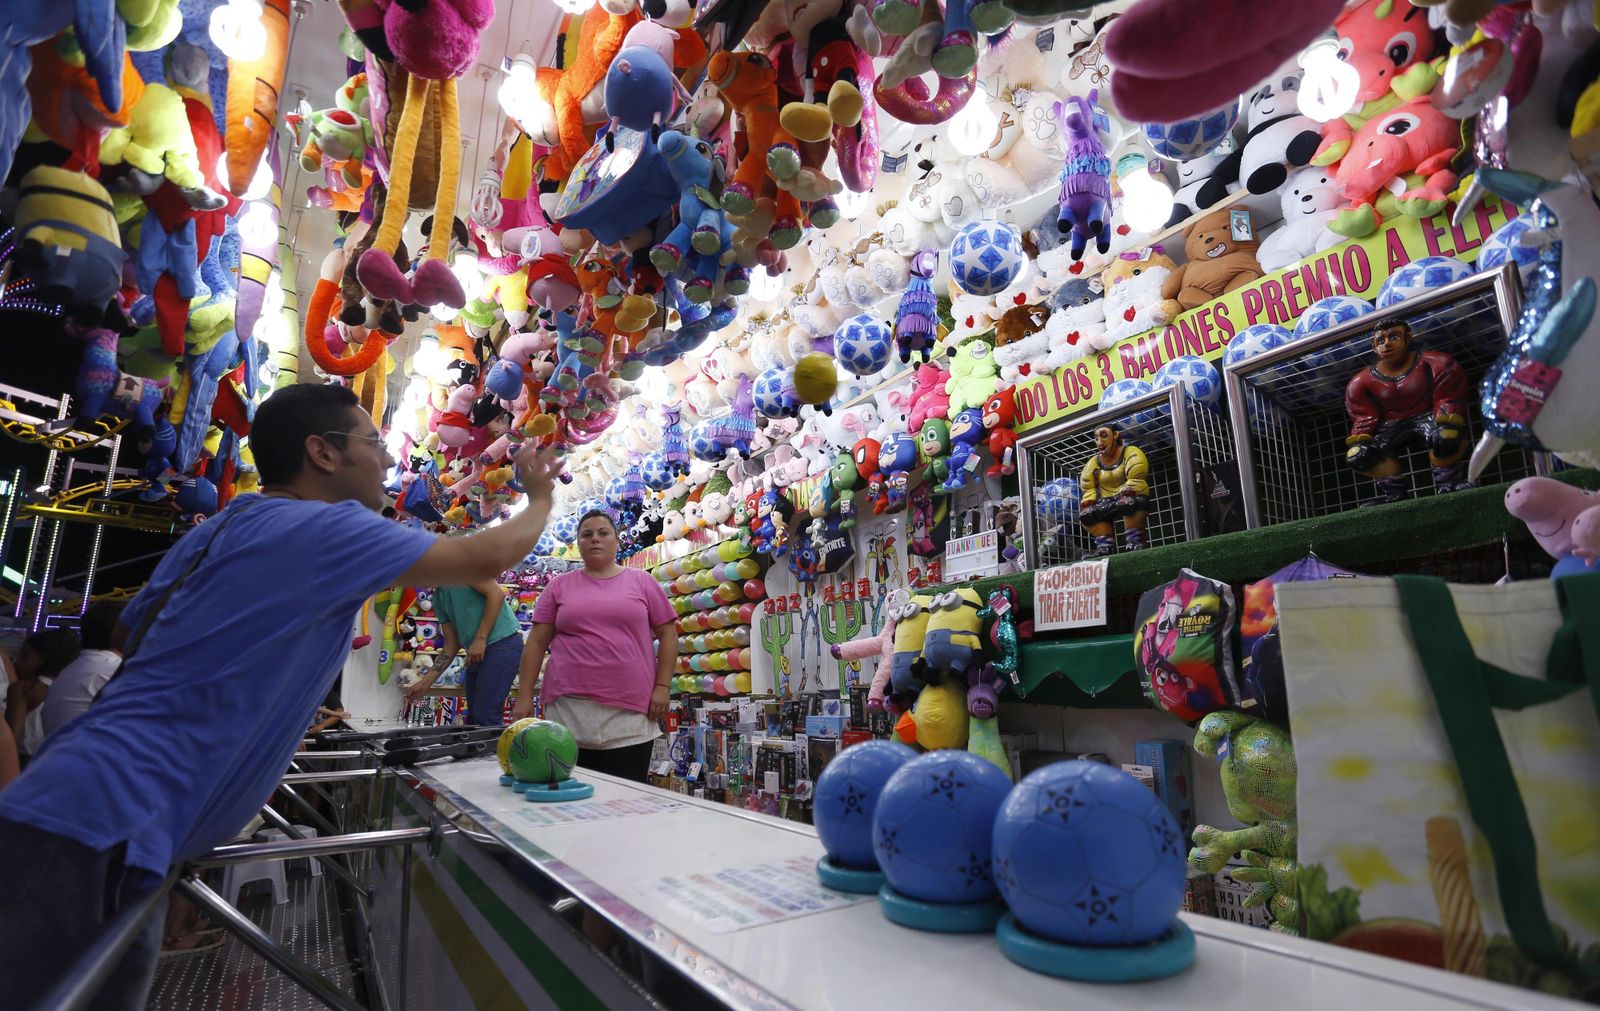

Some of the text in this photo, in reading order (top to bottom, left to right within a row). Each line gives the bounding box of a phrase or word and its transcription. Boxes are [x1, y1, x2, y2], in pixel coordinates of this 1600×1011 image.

[1051, 362, 1093, 410] LOS
[1096, 353, 1115, 391] 3
[1118, 301, 1236, 380] BALONES
[1241, 244, 1372, 326] PREMIO
[1385, 227, 1411, 276] A
[1036, 563, 1104, 592] PROHIBIDO
[1039, 586, 1101, 625] TIRAR FUERTE
[1177, 615, 1212, 627] ROYALE
